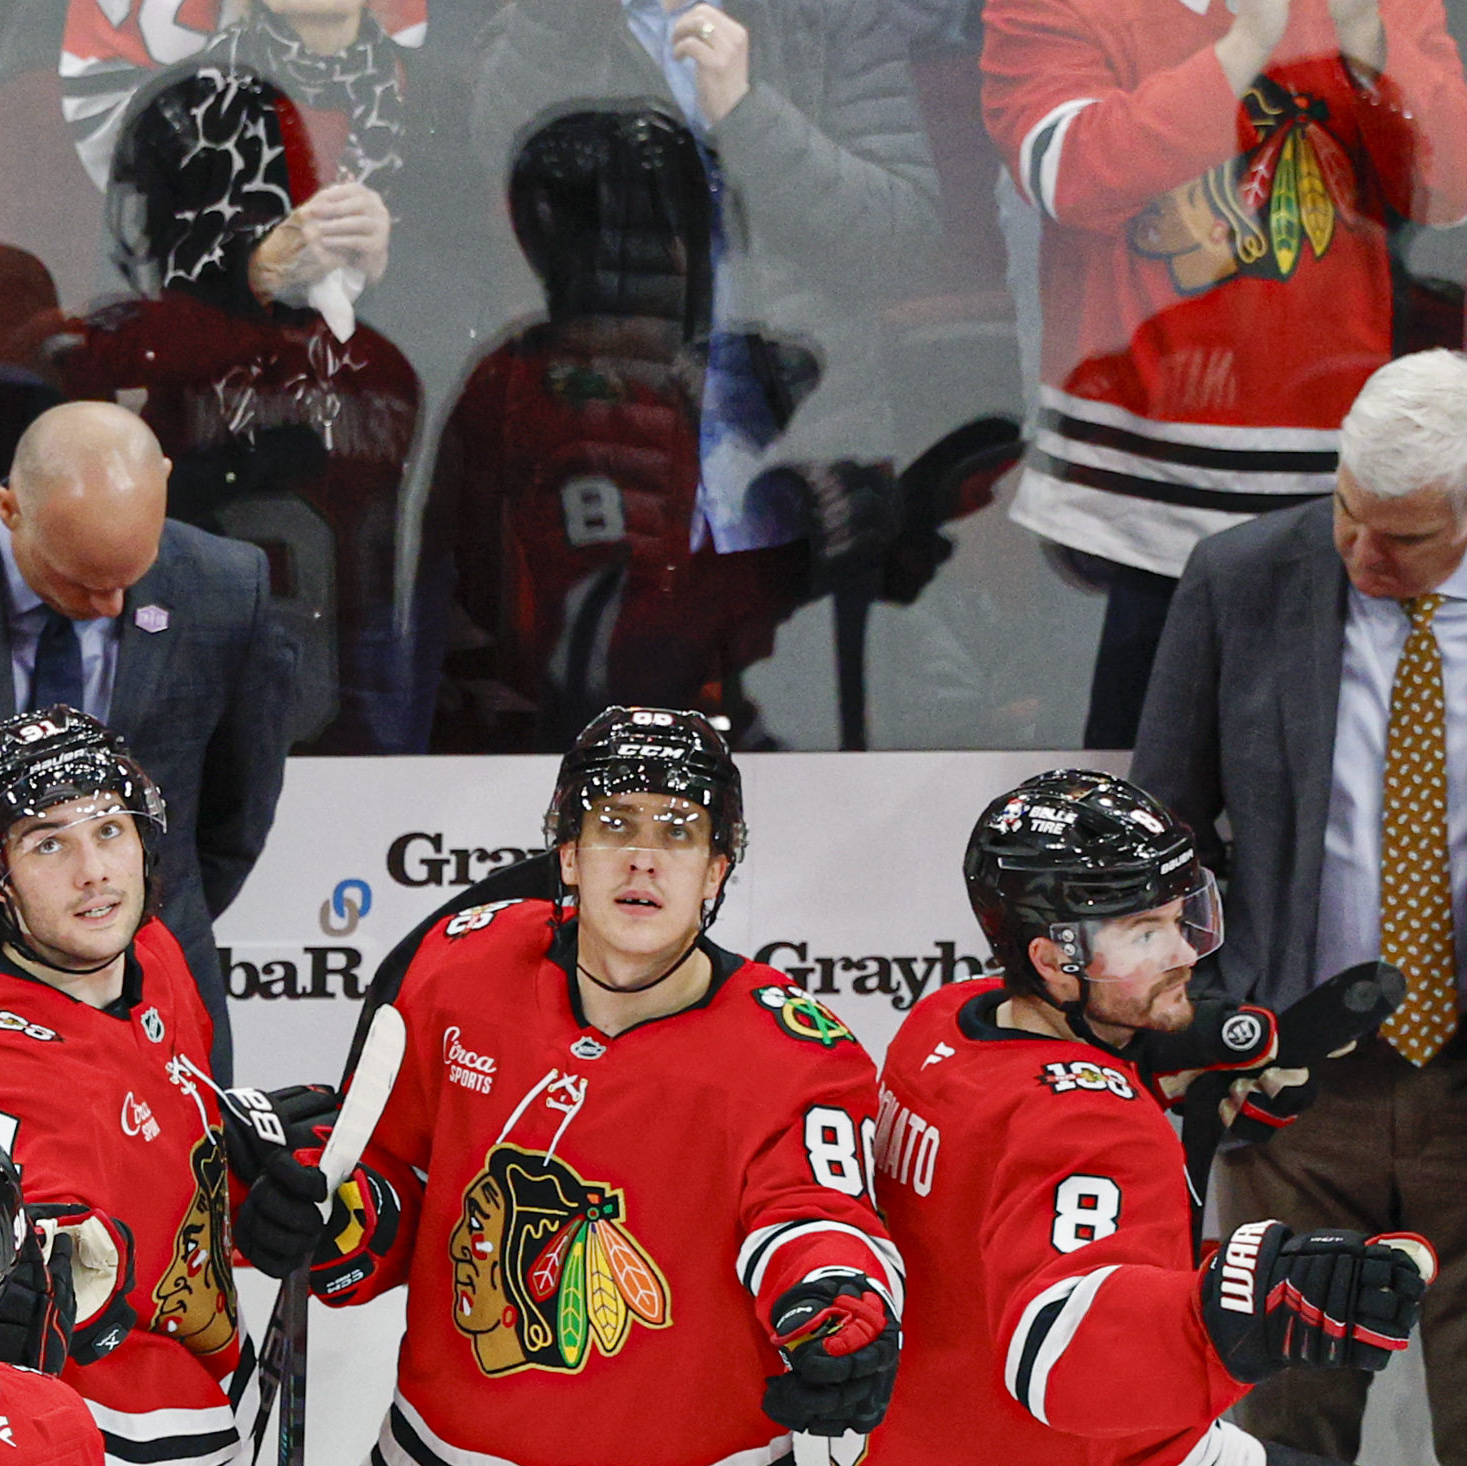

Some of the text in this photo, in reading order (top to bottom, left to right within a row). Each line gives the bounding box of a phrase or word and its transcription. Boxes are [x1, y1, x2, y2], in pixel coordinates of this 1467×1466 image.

[19, 721, 66, 745] 91
[618, 744, 685, 759] CCM
[1028, 806, 1078, 824] BELLE
[1030, 819, 1065, 836] TIRE
[442, 1026, 498, 1075] Circa
[449, 1064, 493, 1095] SPORTS
[1050, 1173, 1122, 1253] 8
